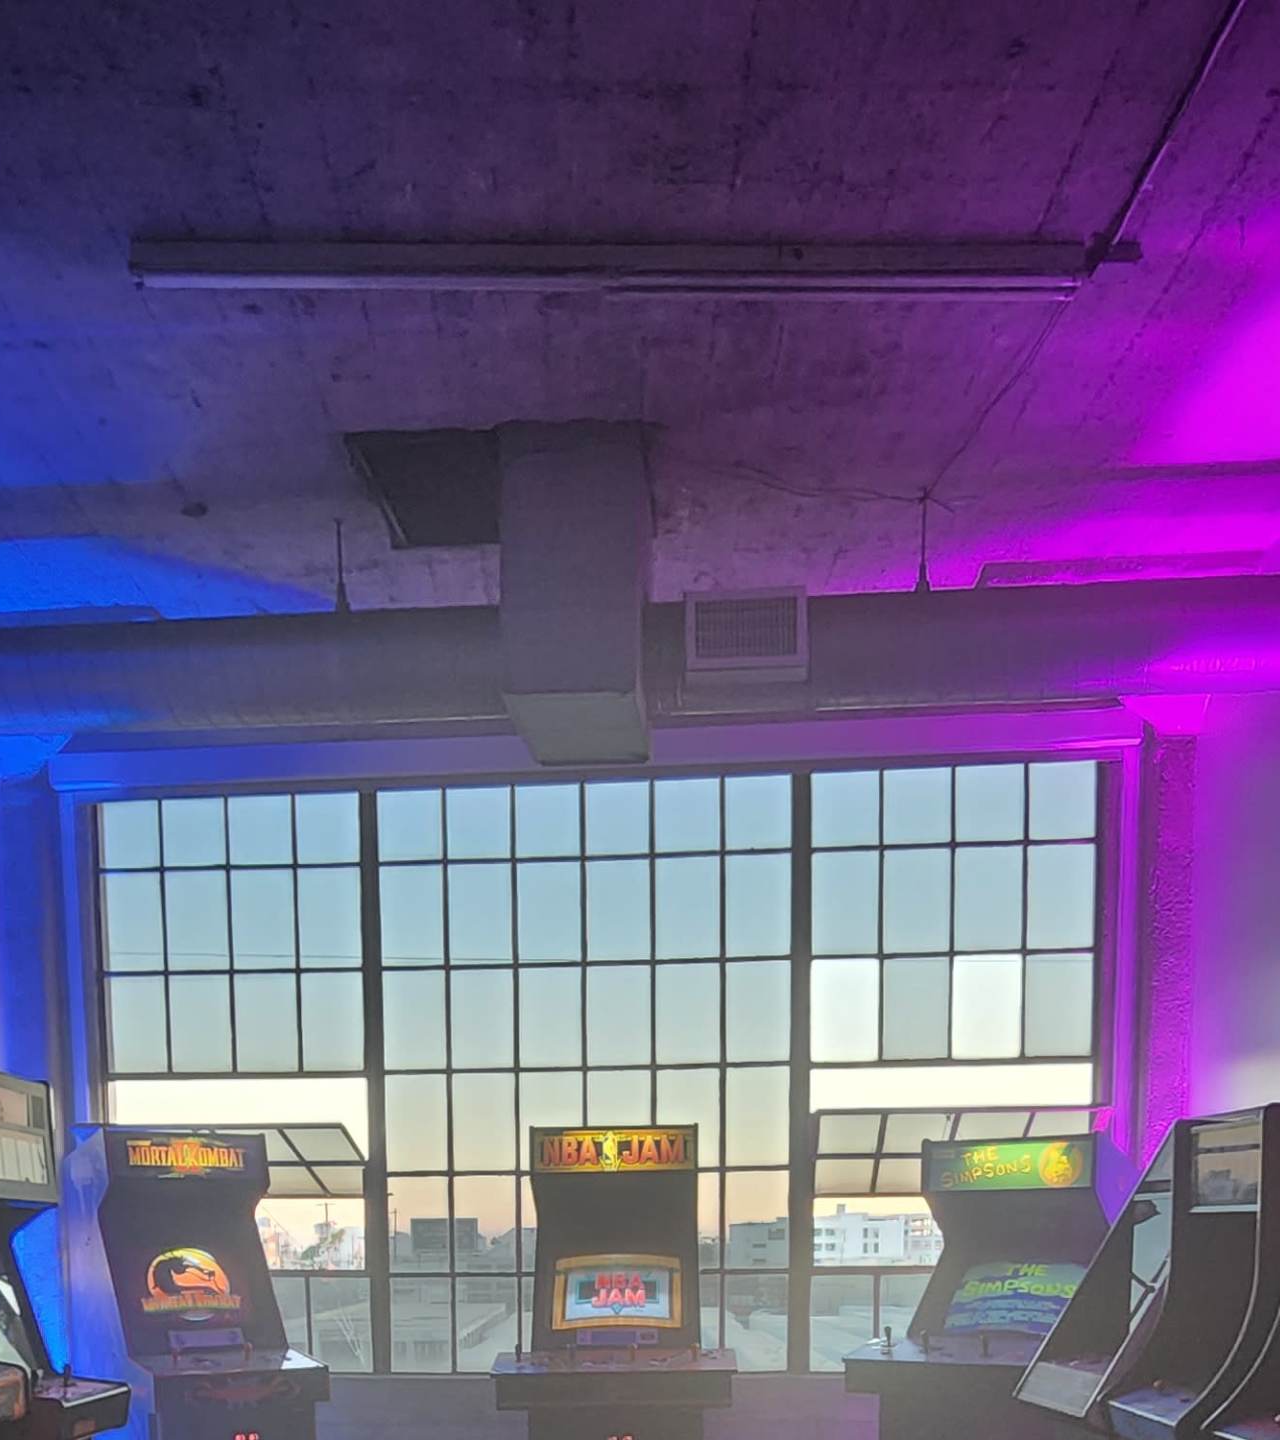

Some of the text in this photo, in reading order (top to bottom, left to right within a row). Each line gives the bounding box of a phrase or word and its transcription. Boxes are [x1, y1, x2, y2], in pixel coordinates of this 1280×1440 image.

[128, 1145, 246, 1168] MORTAL KOMBAT
[543, 1133, 686, 1166] NBA JAM
[961, 1146, 999, 1167] THE
[941, 1154, 1033, 1188] SIMPSONS
[595, 1272, 644, 1289] NBA
[1005, 1264, 1049, 1277] THE
[592, 1288, 646, 1308] JAM
[963, 1279, 1077, 1300] SIMPSONS
